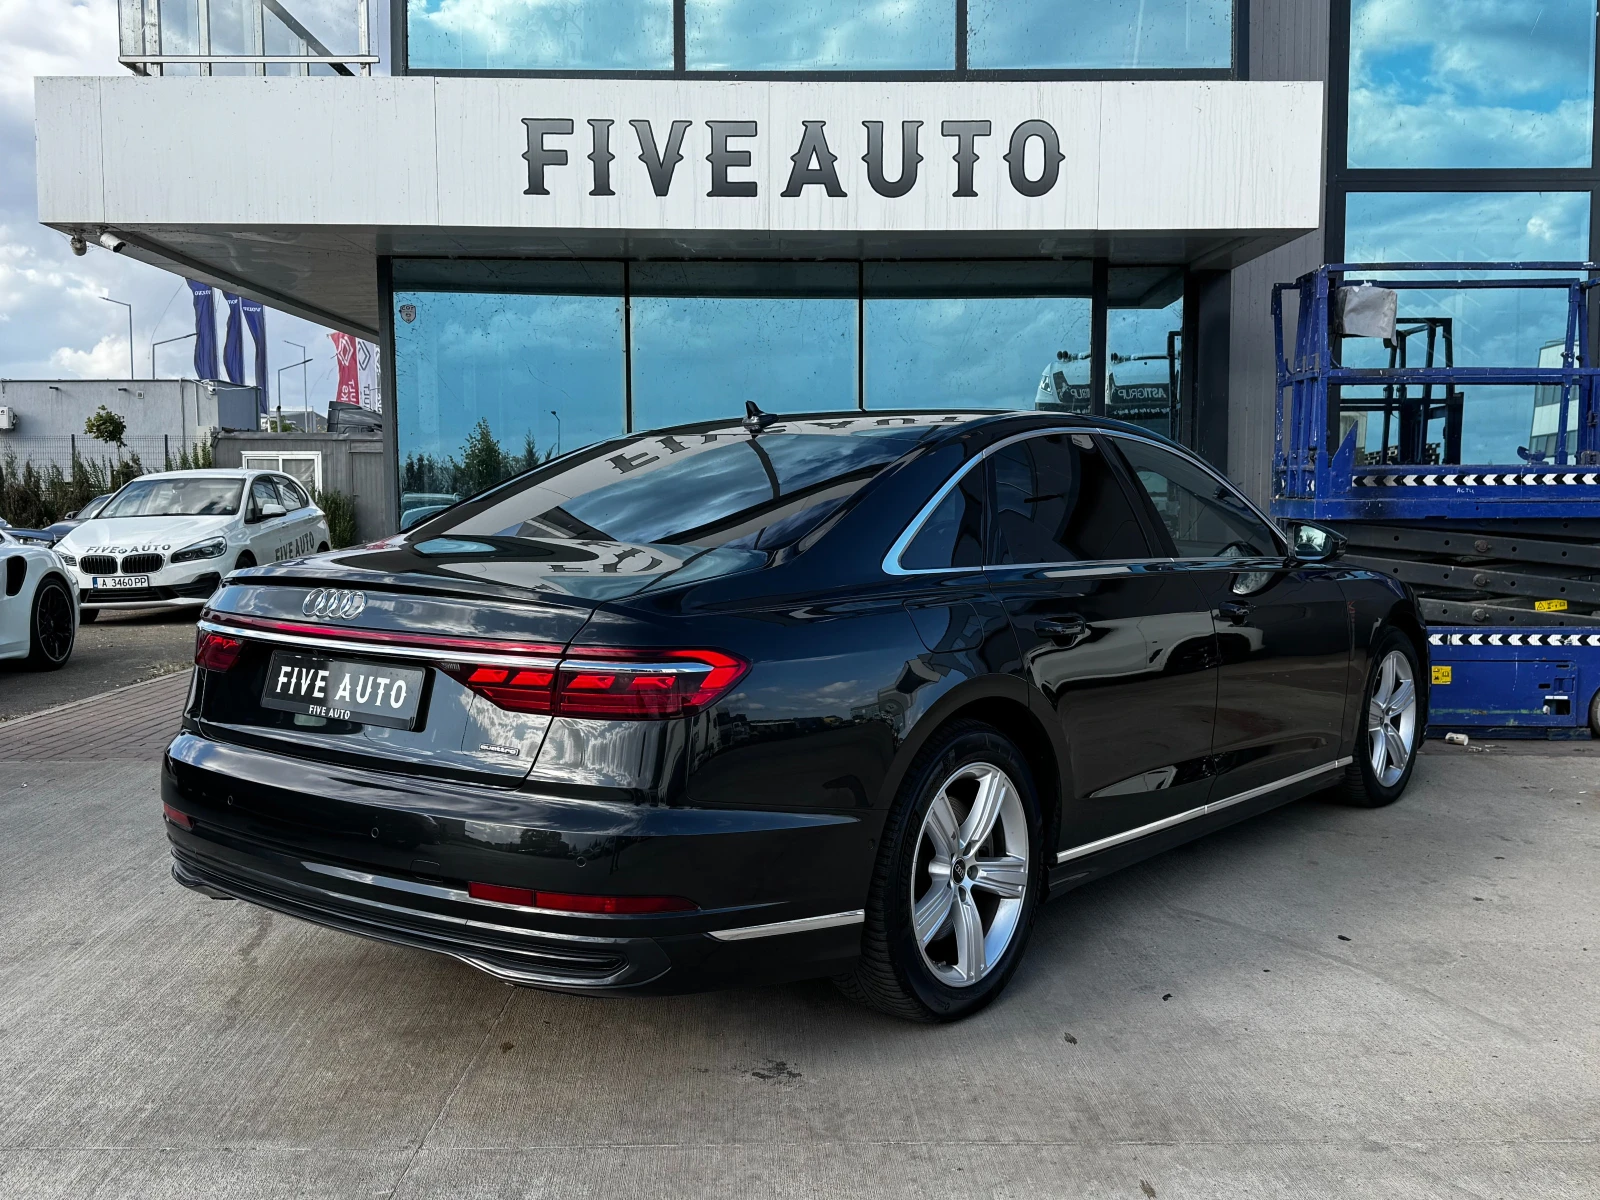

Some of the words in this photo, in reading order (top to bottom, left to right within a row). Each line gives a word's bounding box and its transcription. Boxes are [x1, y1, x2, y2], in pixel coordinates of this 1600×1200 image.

[521, 117, 758, 198] FIVE
[780, 118, 1066, 199] AUTO
[86, 546, 120, 554] FIVE
[129, 544, 171, 554] AUTO
[275, 541, 294, 561] FIVE
[295, 531, 315, 557] AUTO
[102, 579, 108, 588] A
[111, 578, 133, 588] 3460
[134, 577, 147, 587] PP
[275, 665, 330, 698] FIVE
[334, 673, 407, 709] AUTO
[309, 704, 327, 716] FIVE
[328, 707, 351, 720] AUTO
